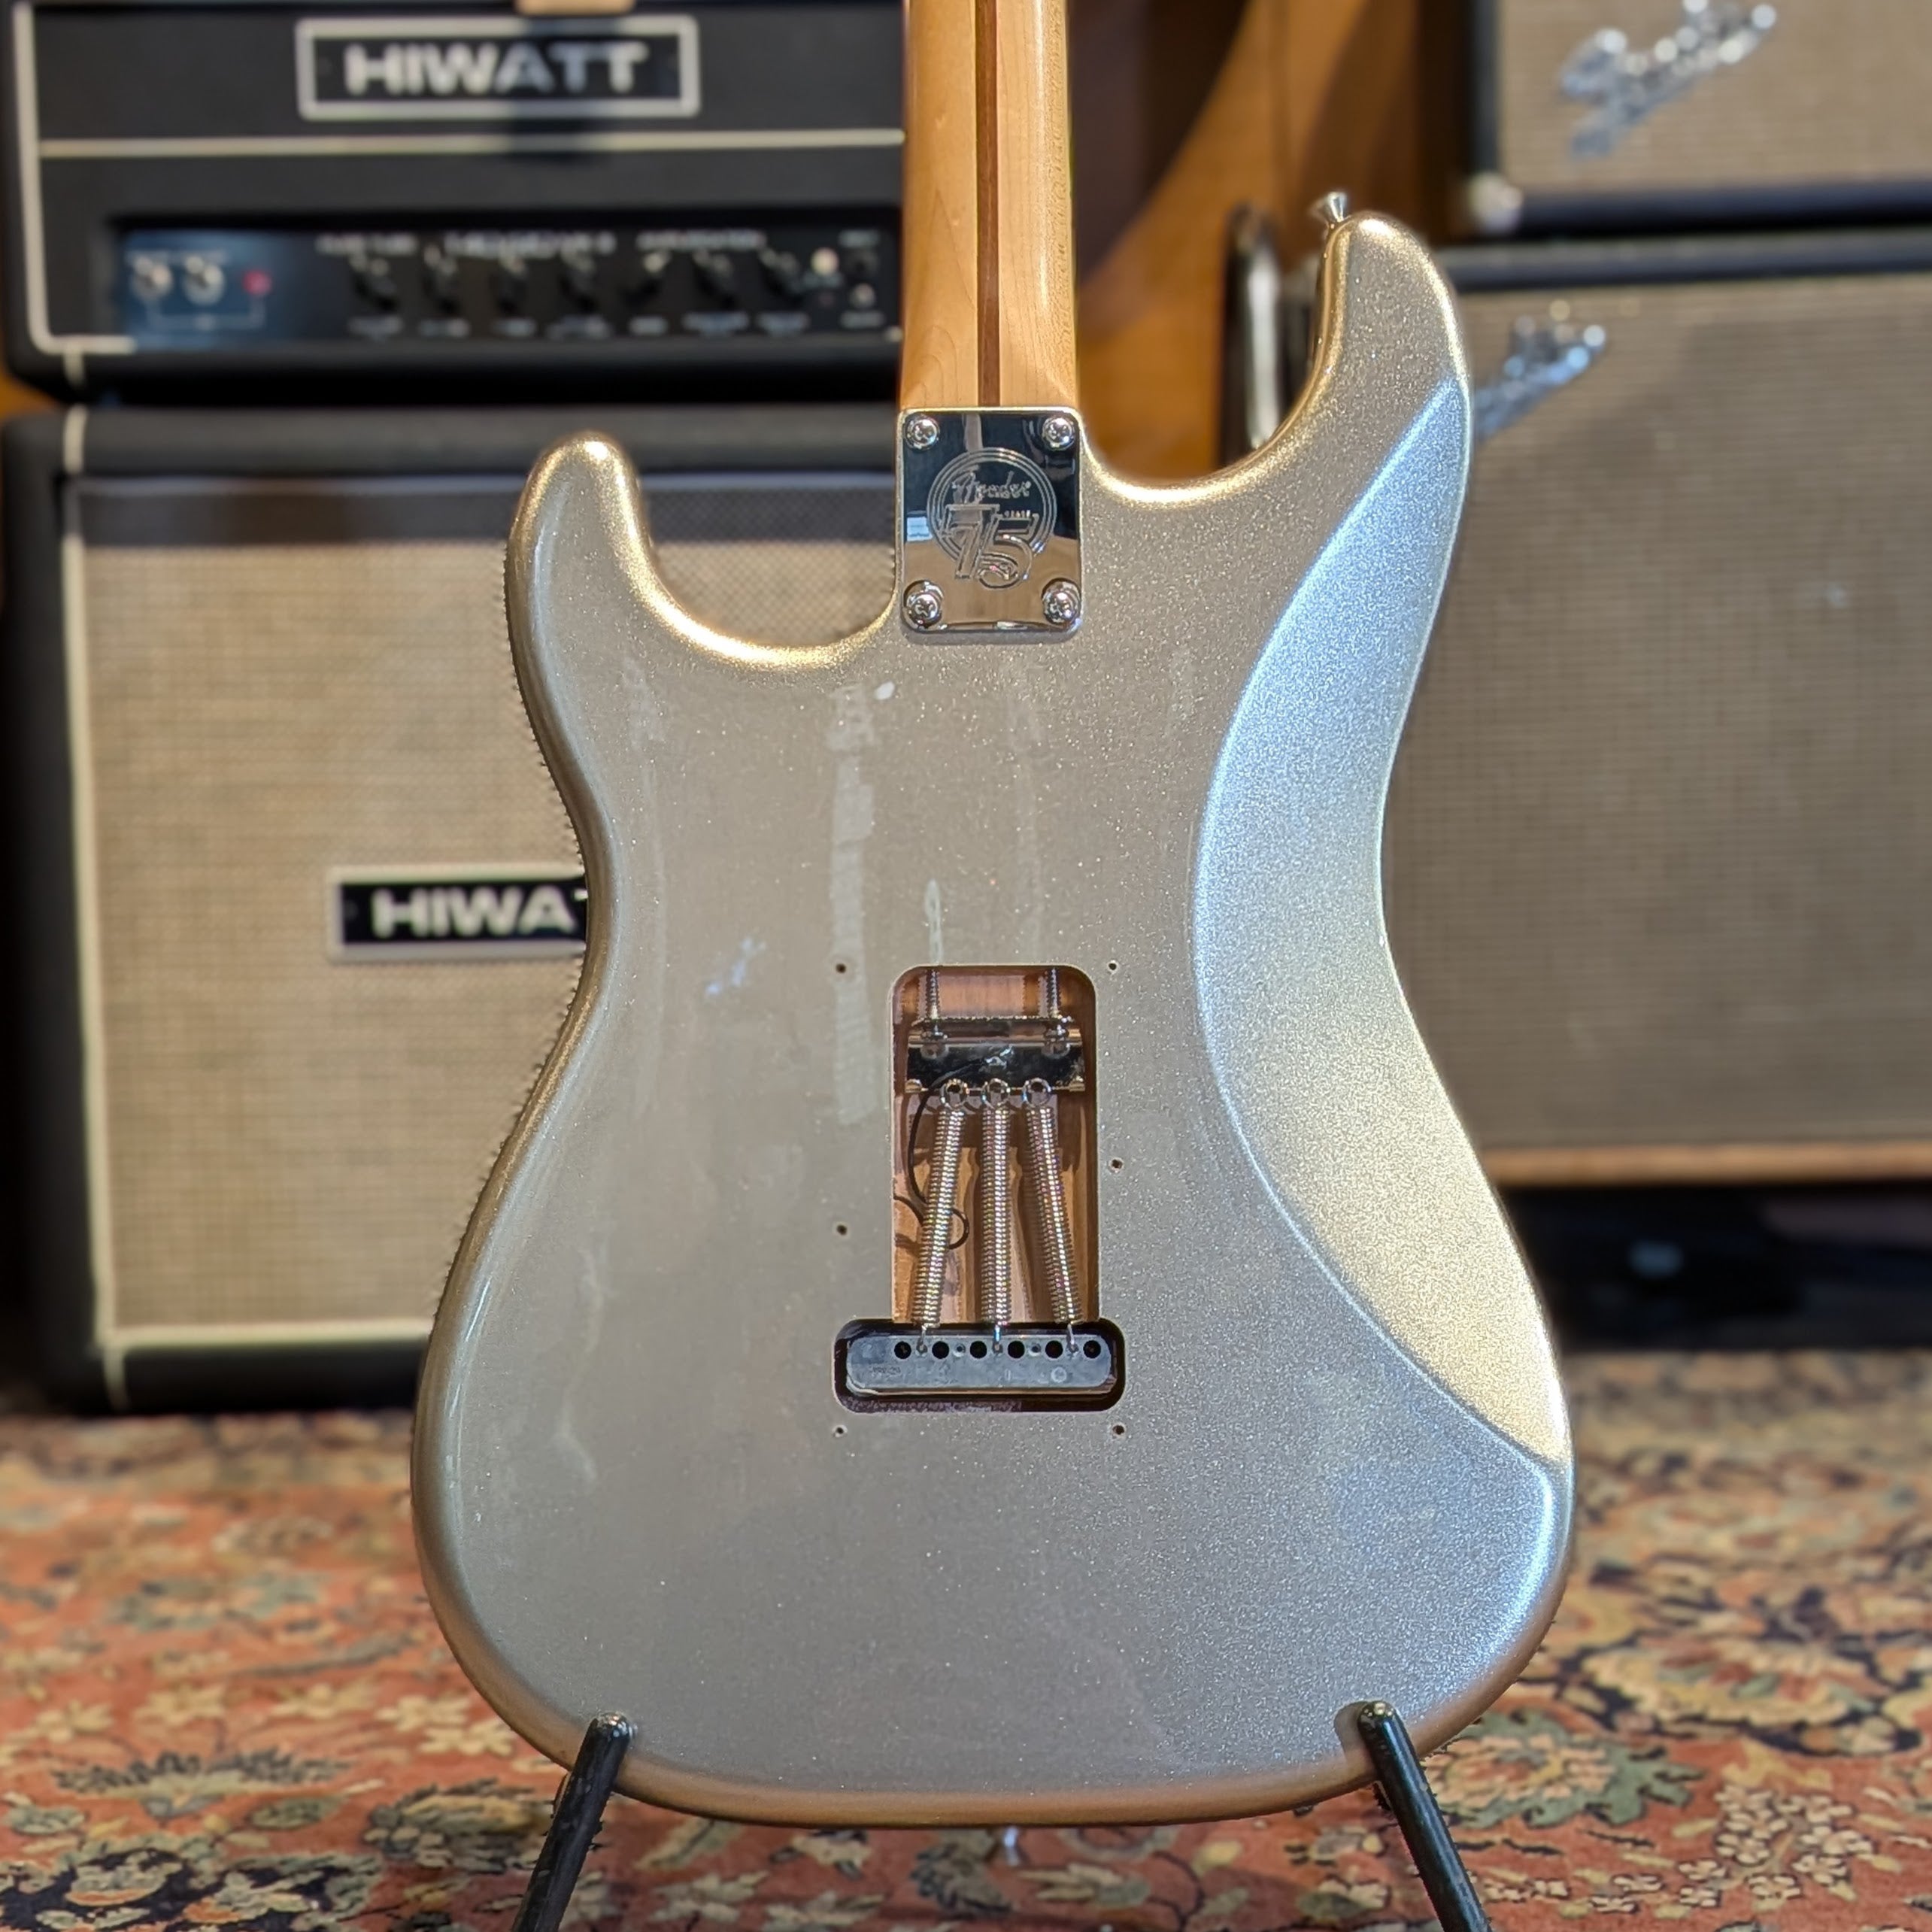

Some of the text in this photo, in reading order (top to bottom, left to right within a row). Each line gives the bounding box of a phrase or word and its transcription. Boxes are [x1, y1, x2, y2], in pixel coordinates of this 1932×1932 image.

[344, 41, 648, 96] HIWATT
[951, 468, 1032, 504] Fender
[940, 504, 1039, 589] 75
[371, 884, 588, 938] HIWA
